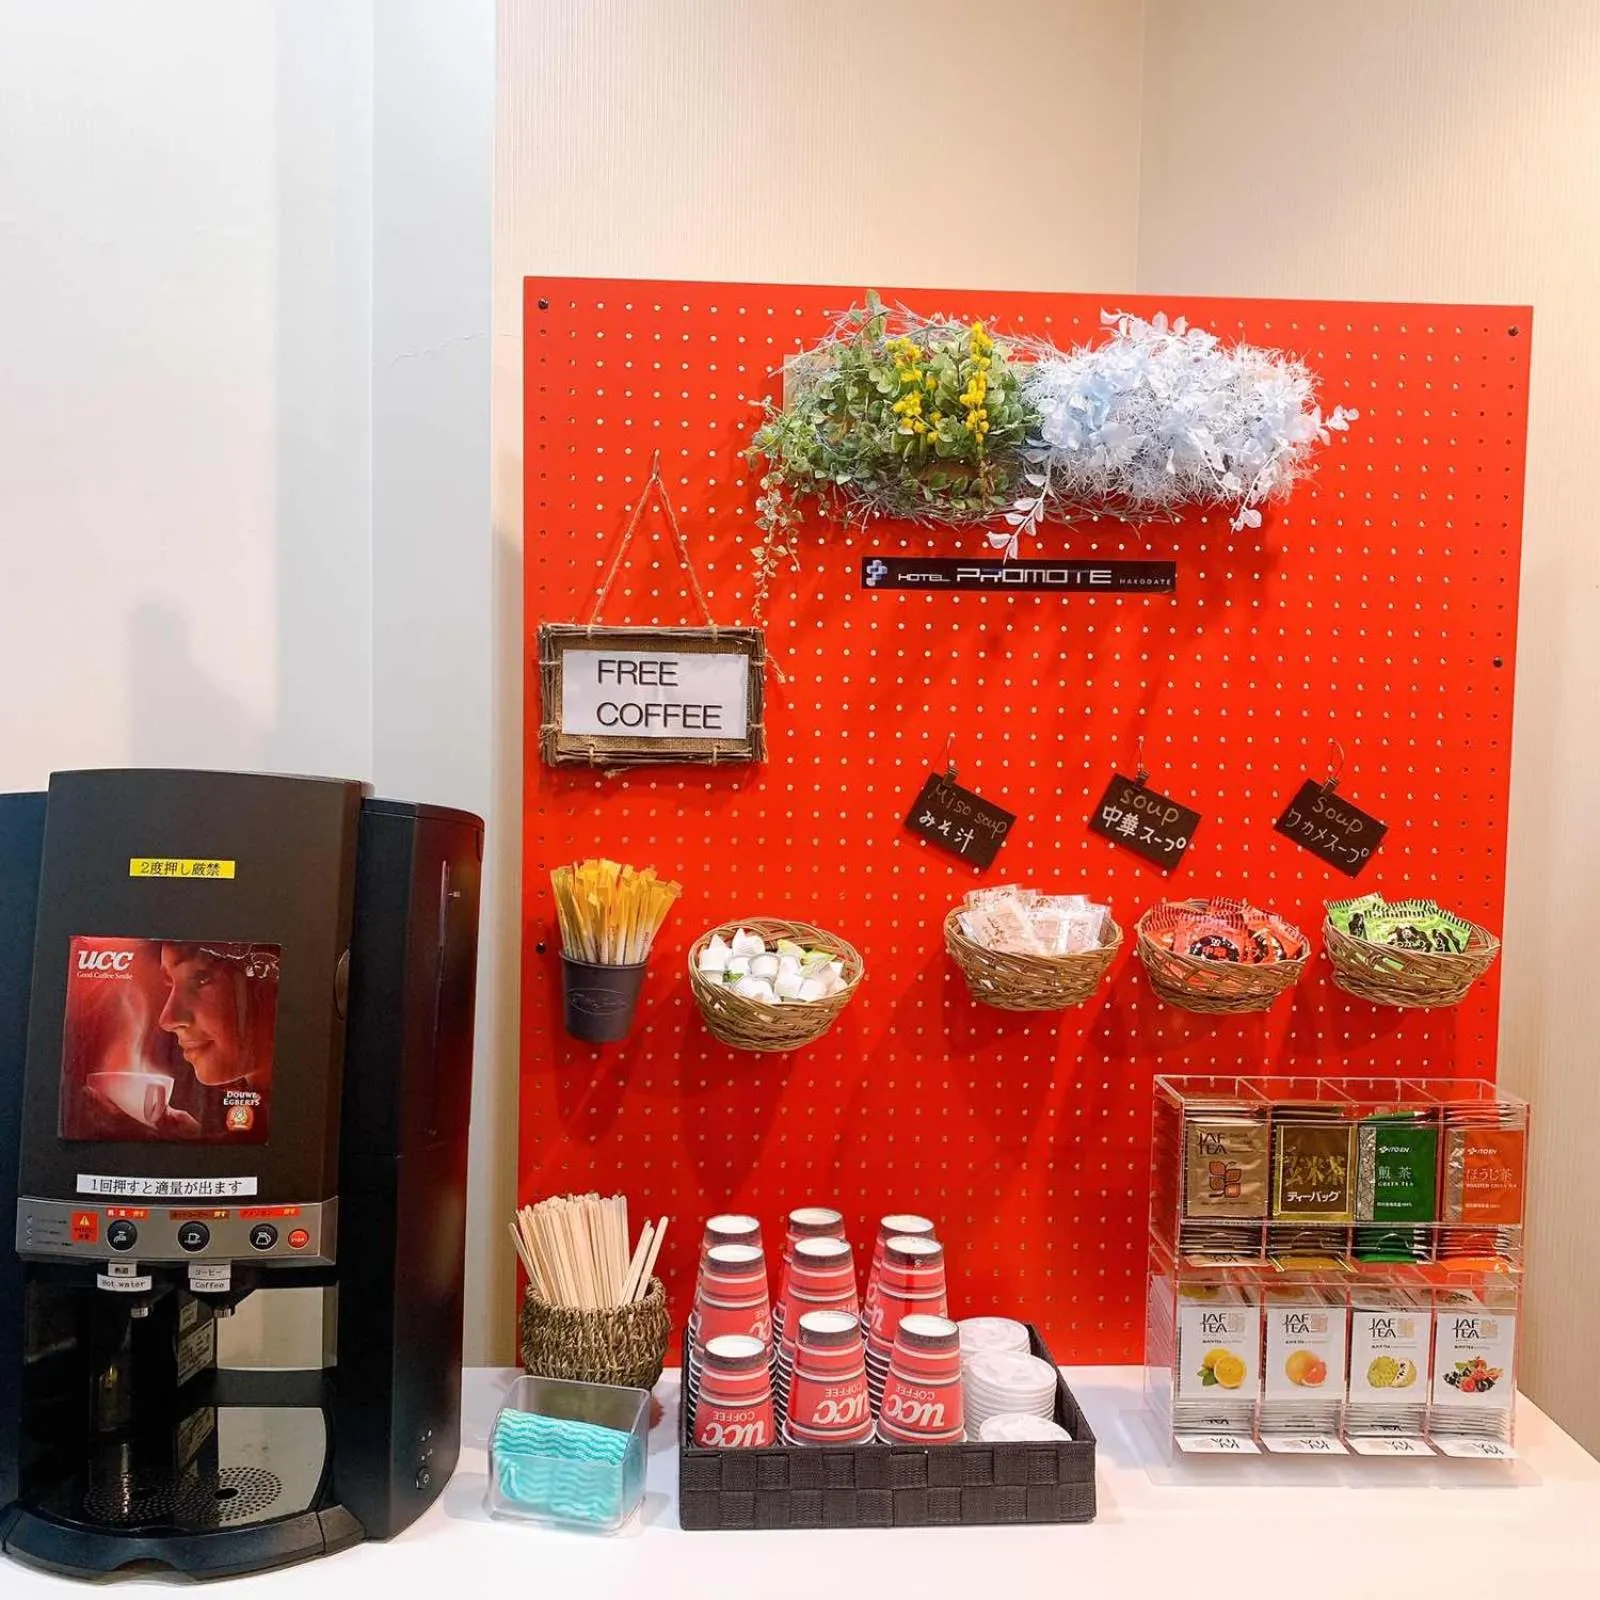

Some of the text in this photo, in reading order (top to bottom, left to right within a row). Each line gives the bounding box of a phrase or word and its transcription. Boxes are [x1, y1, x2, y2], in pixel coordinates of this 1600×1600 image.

[898, 568, 1172, 586] HOTEL PROMOTE HAKODATE
[597, 660, 679, 687] FREE
[596, 701, 723, 730] COFFEE
[918, 810, 974, 854] みそ汁
[1102, 805, 1187, 852] 中華スープ
[1285, 808, 1370, 864] ワカメスープ
[140, 861, 221, 877] 2度押し厳禁
[223, 1098, 261, 1106] EGBERTS
[226, 1090, 258, 1099] DOUWE
[91, 1178, 243, 1197] 1回押すと適量が出ます
[1287, 1190, 1342, 1202] ティーバッグ
[194, 1280, 225, 1290] Coffee
[1202, 1323, 1228, 1333] TEA
[1286, 1323, 1310, 1333] TEA
[1372, 1328, 1396, 1338] TEA
[1455, 1328, 1480, 1339] TEA
[895, 1384, 936, 1401] COFFEE
[713, 1410, 756, 1424] COFFEE
